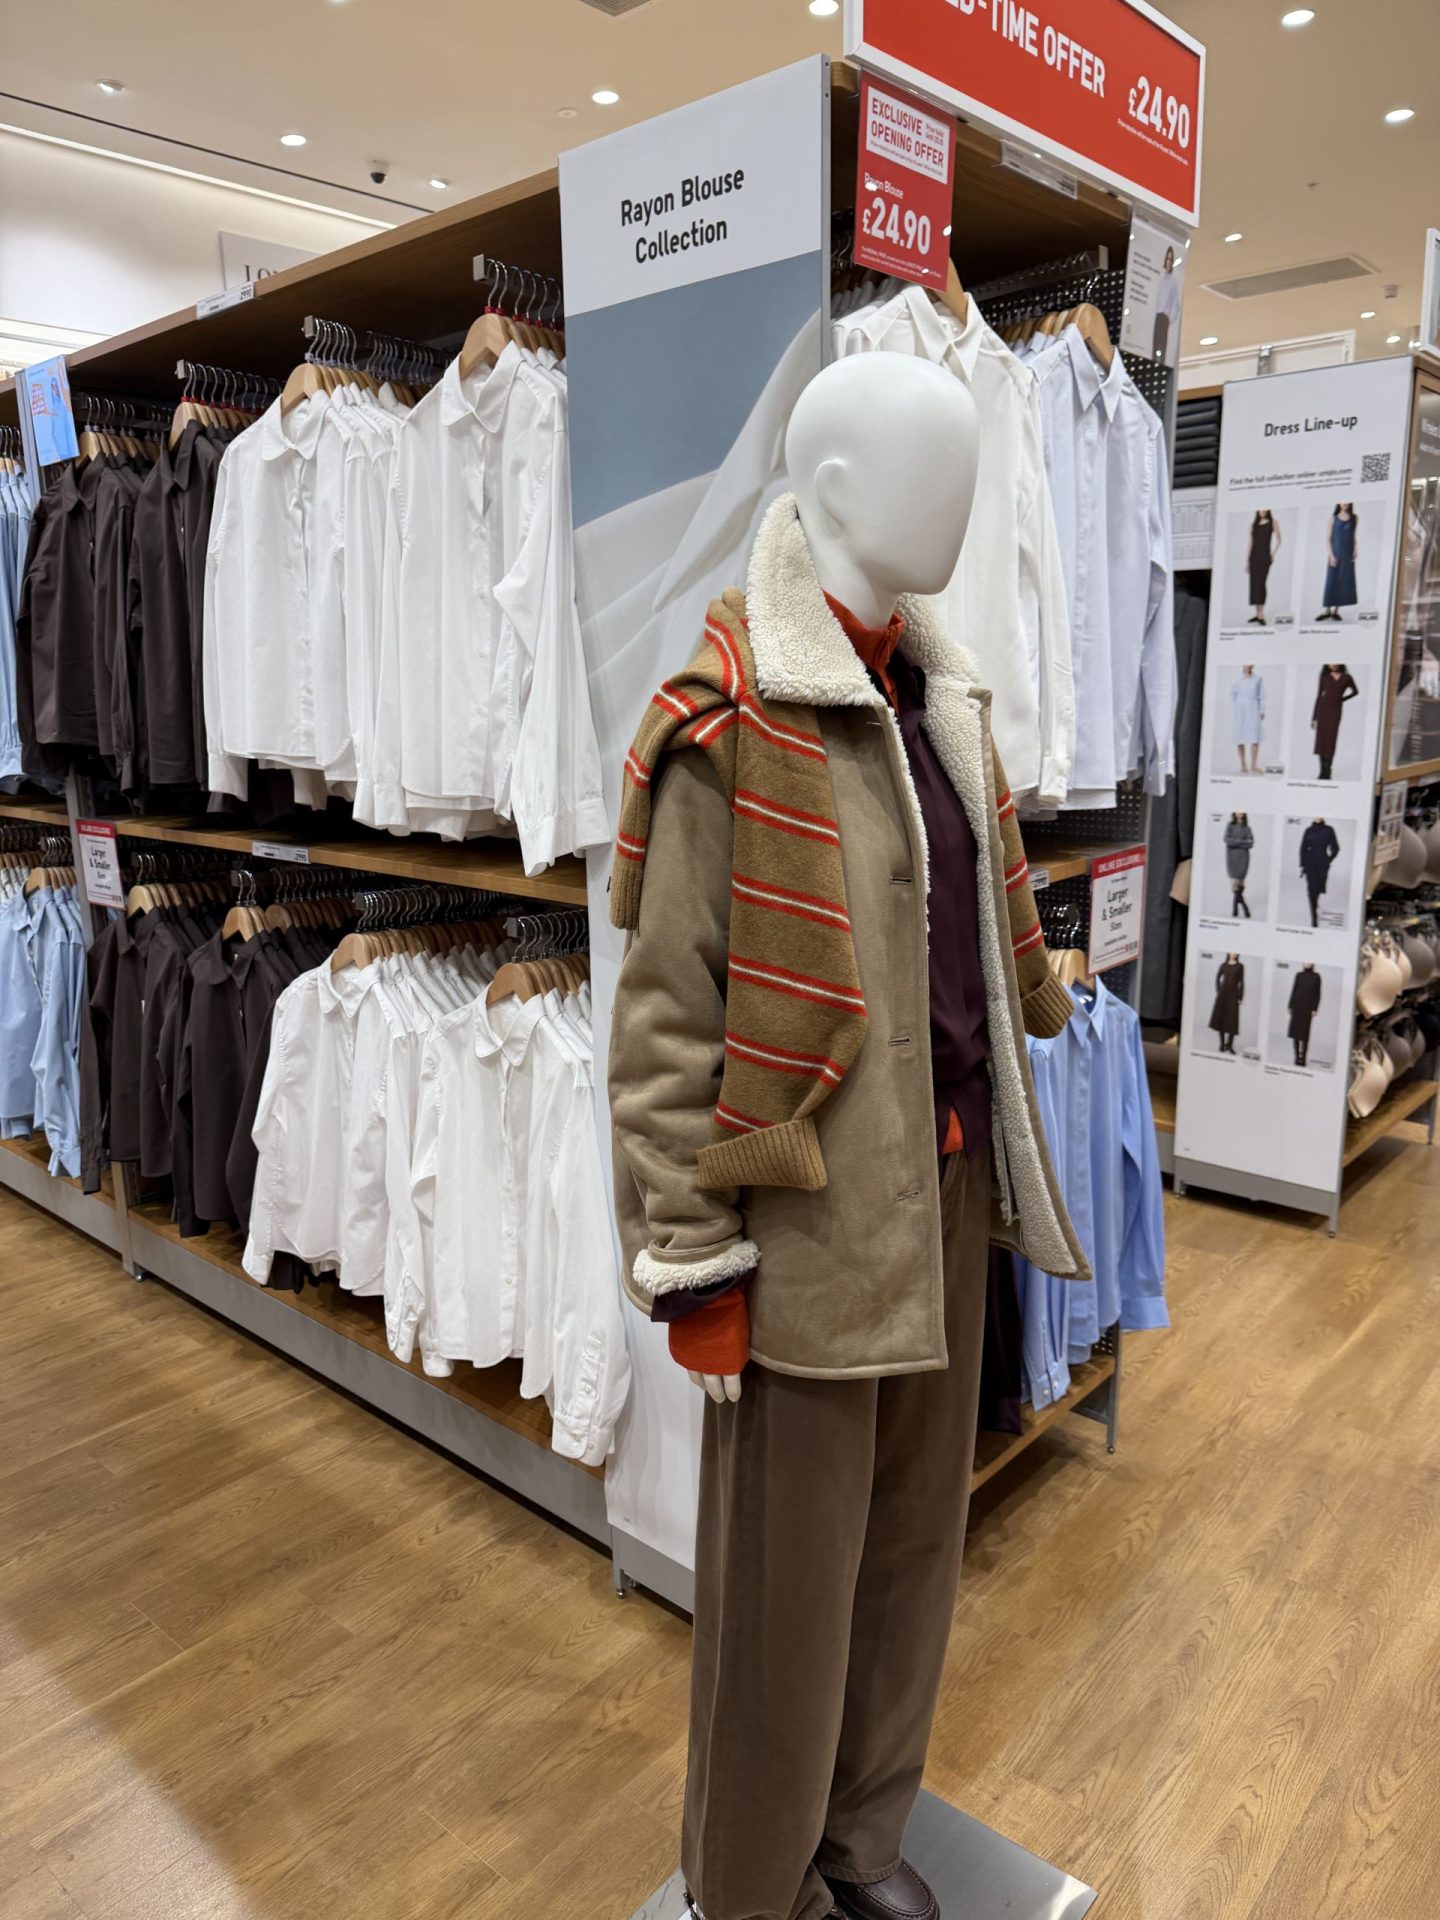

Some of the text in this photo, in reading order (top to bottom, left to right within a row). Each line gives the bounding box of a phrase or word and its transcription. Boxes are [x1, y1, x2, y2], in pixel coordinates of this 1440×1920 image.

[944, 0, 1106, 99] -TIME OFFER
[871, 97, 923, 136] EXCLUSIVE
[1128, 75, 1190, 149] £24.90
[871, 120, 913, 153] OPENING
[914, 140, 945, 168] OFFER
[621, 169, 745, 227] Rayon Blouse
[884, 180, 904, 199] Blouse
[635, 219, 728, 264] Collection
[862, 197, 931, 255] £24.90
[1264, 415, 1358, 437] Dress Line-up
[1107, 887, 1128, 903] Larger
[1109, 901, 1133, 919] Smaller
